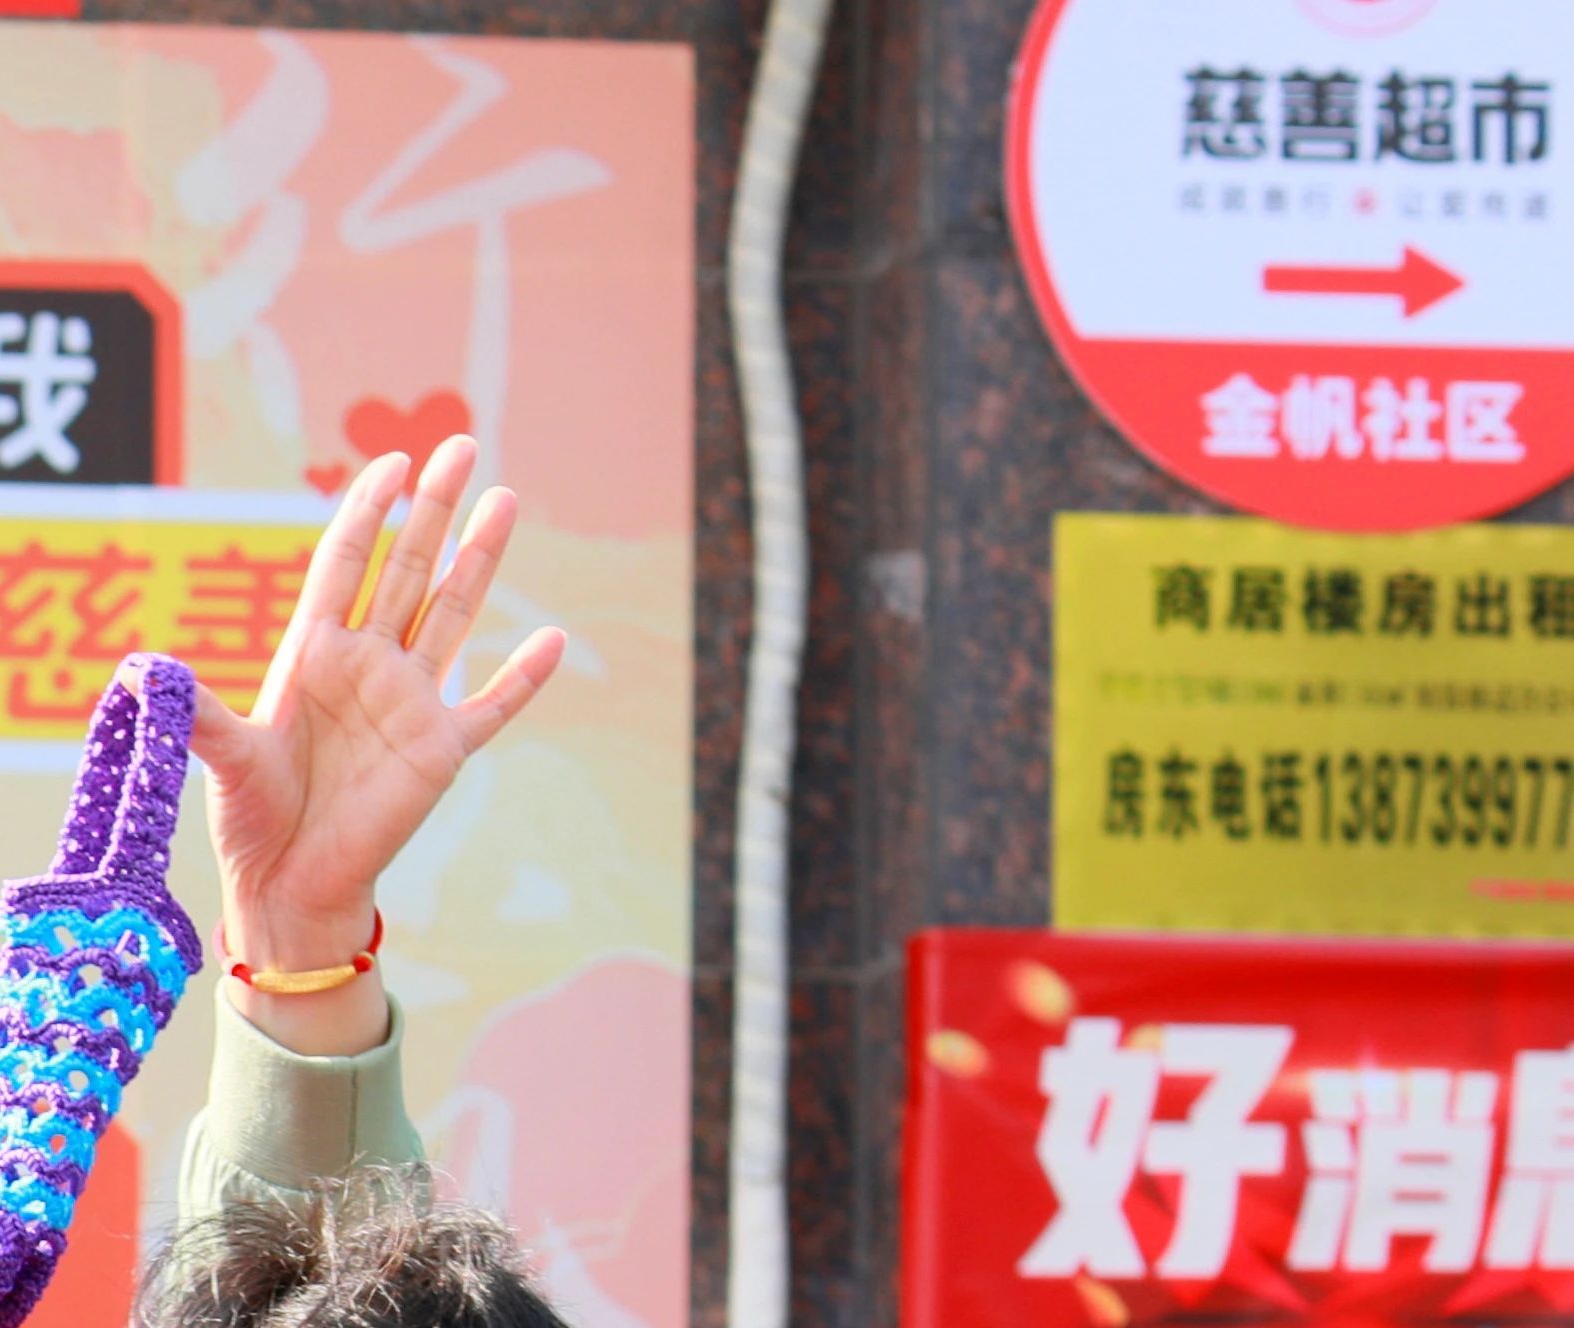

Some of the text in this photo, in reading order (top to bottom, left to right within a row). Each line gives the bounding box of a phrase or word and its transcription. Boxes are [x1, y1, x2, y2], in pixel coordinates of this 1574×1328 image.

[1181, 65, 1551, 165] 慈善超市
[1199, 370, 1527, 463] 金帆社区
